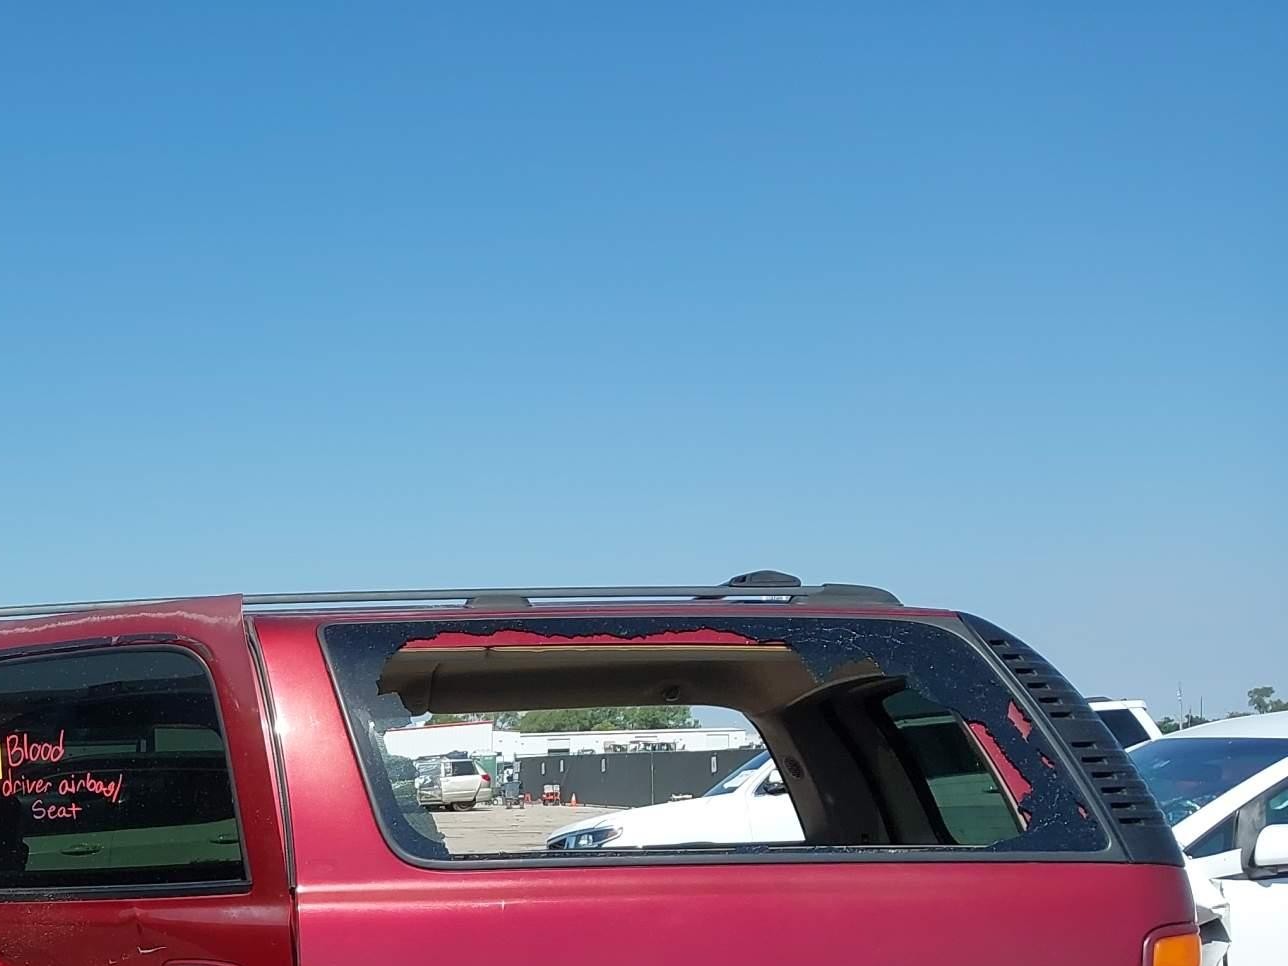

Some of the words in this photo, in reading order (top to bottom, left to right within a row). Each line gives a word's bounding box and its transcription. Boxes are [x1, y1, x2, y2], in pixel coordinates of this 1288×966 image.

[7, 729, 64, 767] Blood
[2, 768, 52, 796] driver
[32, 799, 83, 819] Seat
